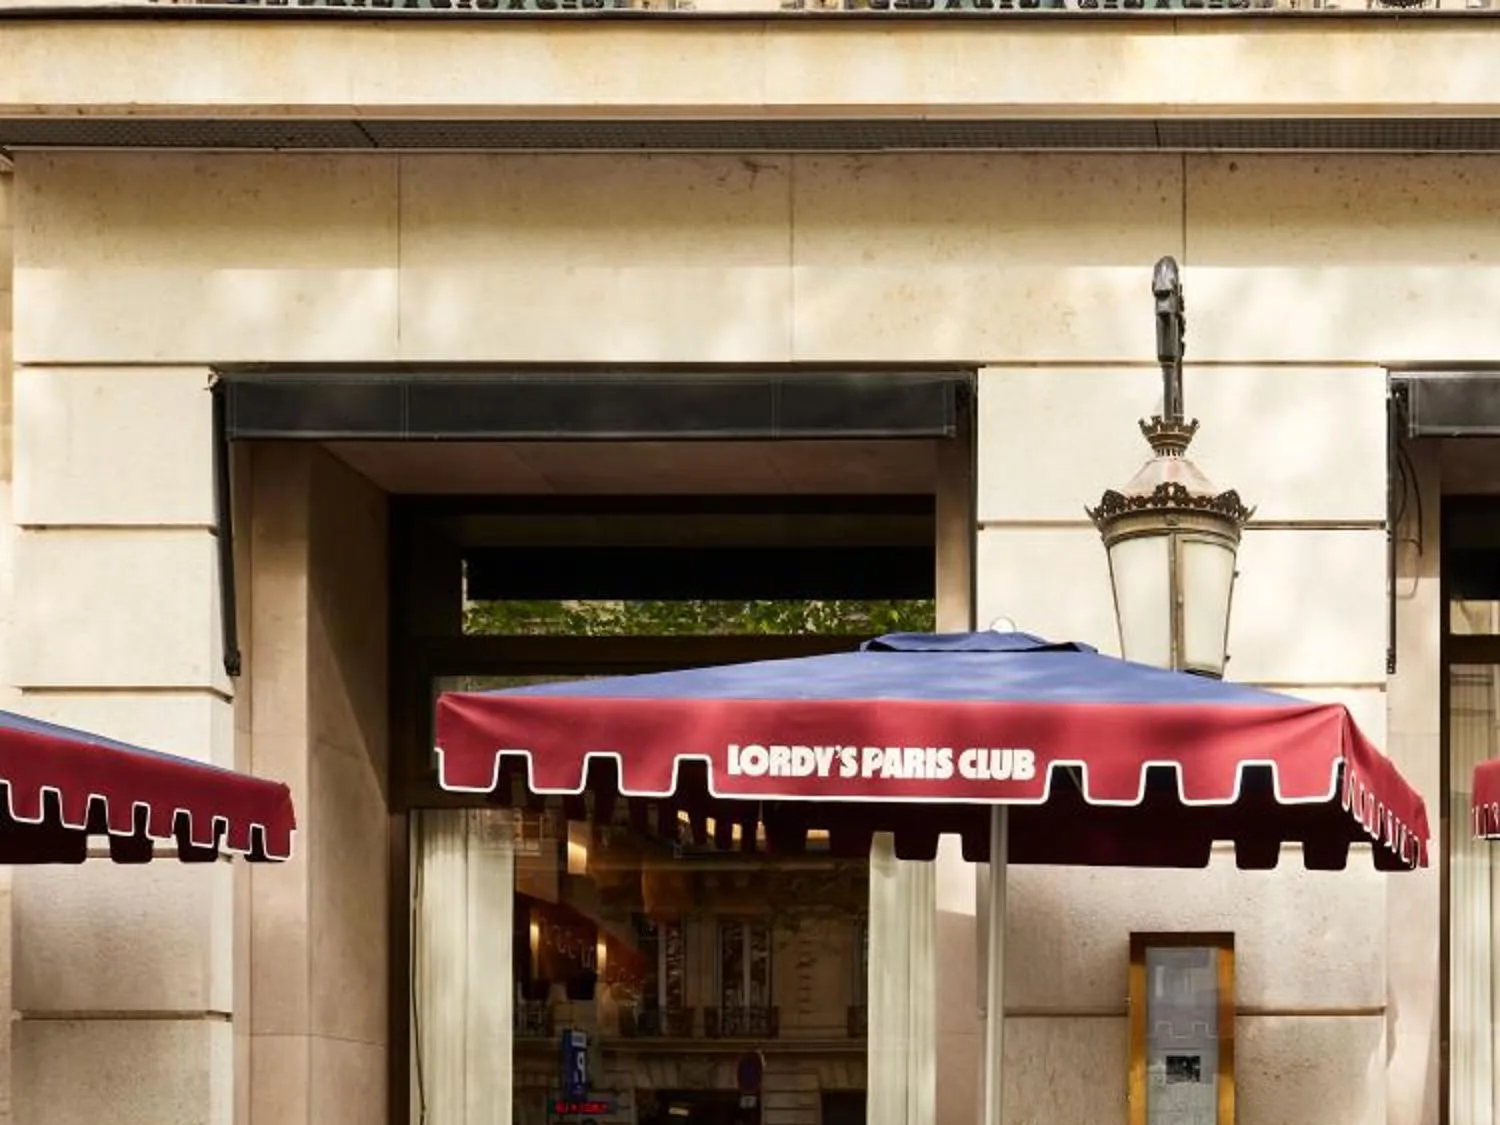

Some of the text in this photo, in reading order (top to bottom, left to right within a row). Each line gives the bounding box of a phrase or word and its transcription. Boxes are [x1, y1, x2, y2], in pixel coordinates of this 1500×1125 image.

[727, 744, 1036, 780] LORDY'S PARIS CLUB
